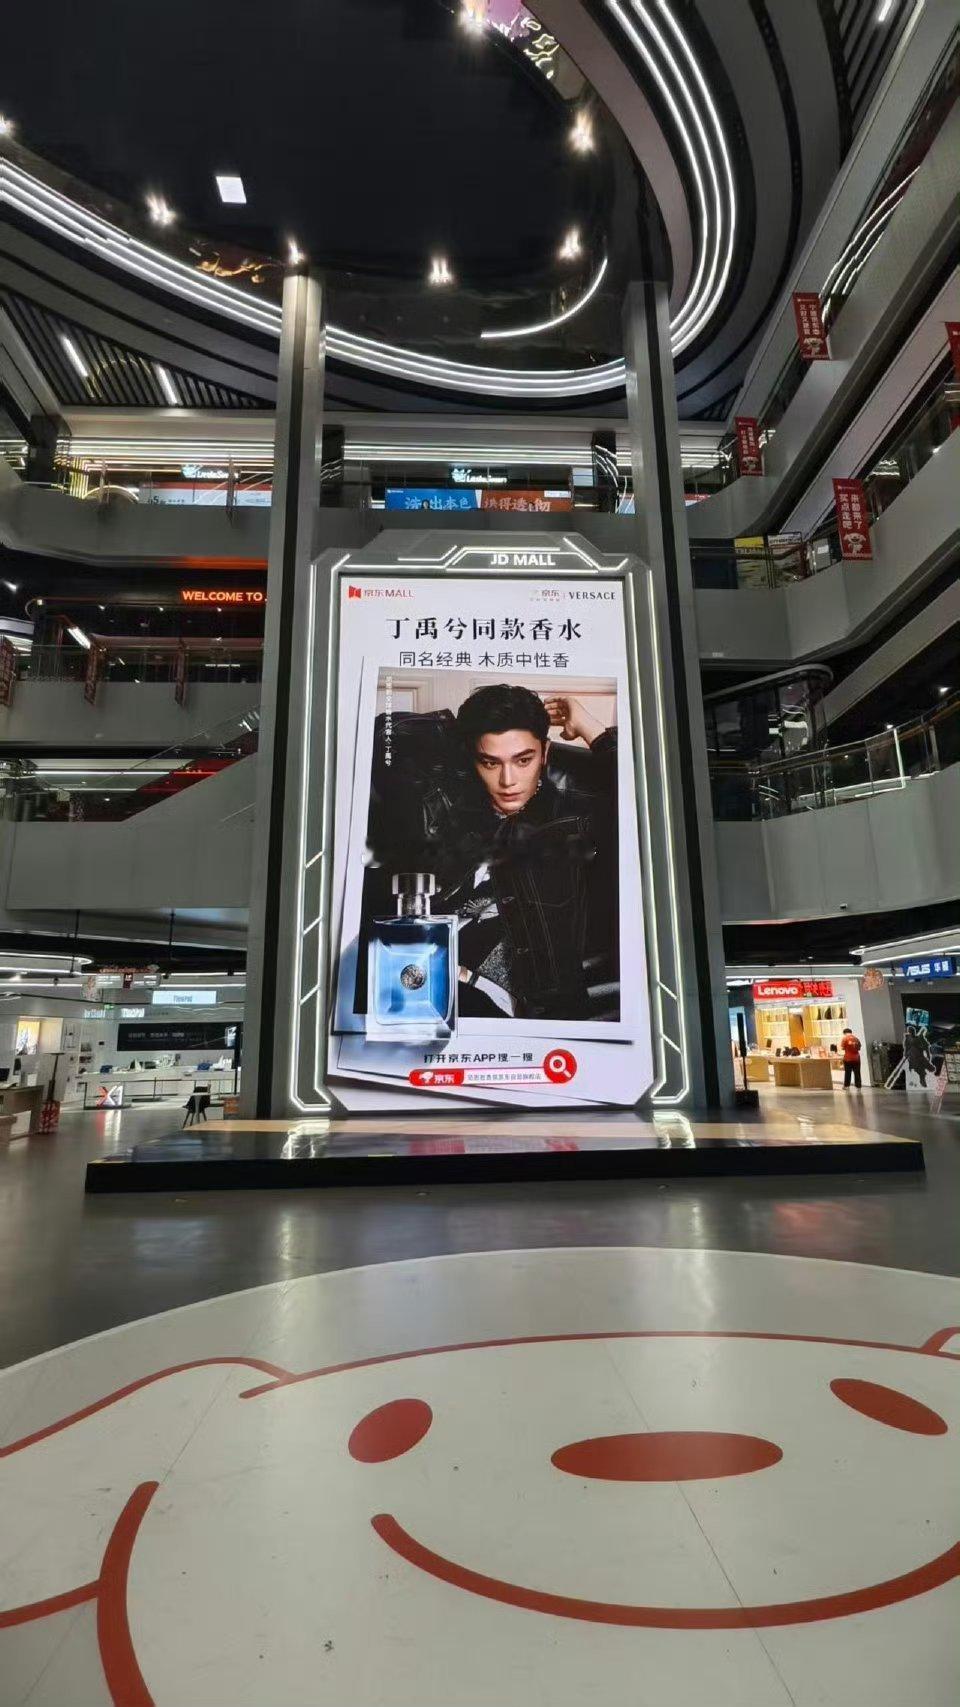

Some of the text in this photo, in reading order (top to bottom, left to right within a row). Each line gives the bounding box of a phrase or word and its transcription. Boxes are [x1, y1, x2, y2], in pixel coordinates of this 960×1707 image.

[490, 554, 556, 566] JD MALL
[182, 591, 263, 601] WELCOME TO
[568, 591, 616, 600] VERSACE
[385, 618, 582, 641] 丁禹兮同款香水
[400, 652, 570, 668] 同名经典 木质中性香
[906, 964, 931, 975] ASUS
[757, 986, 799, 996] Lenovo
[434, 1074, 455, 1083] 京东
